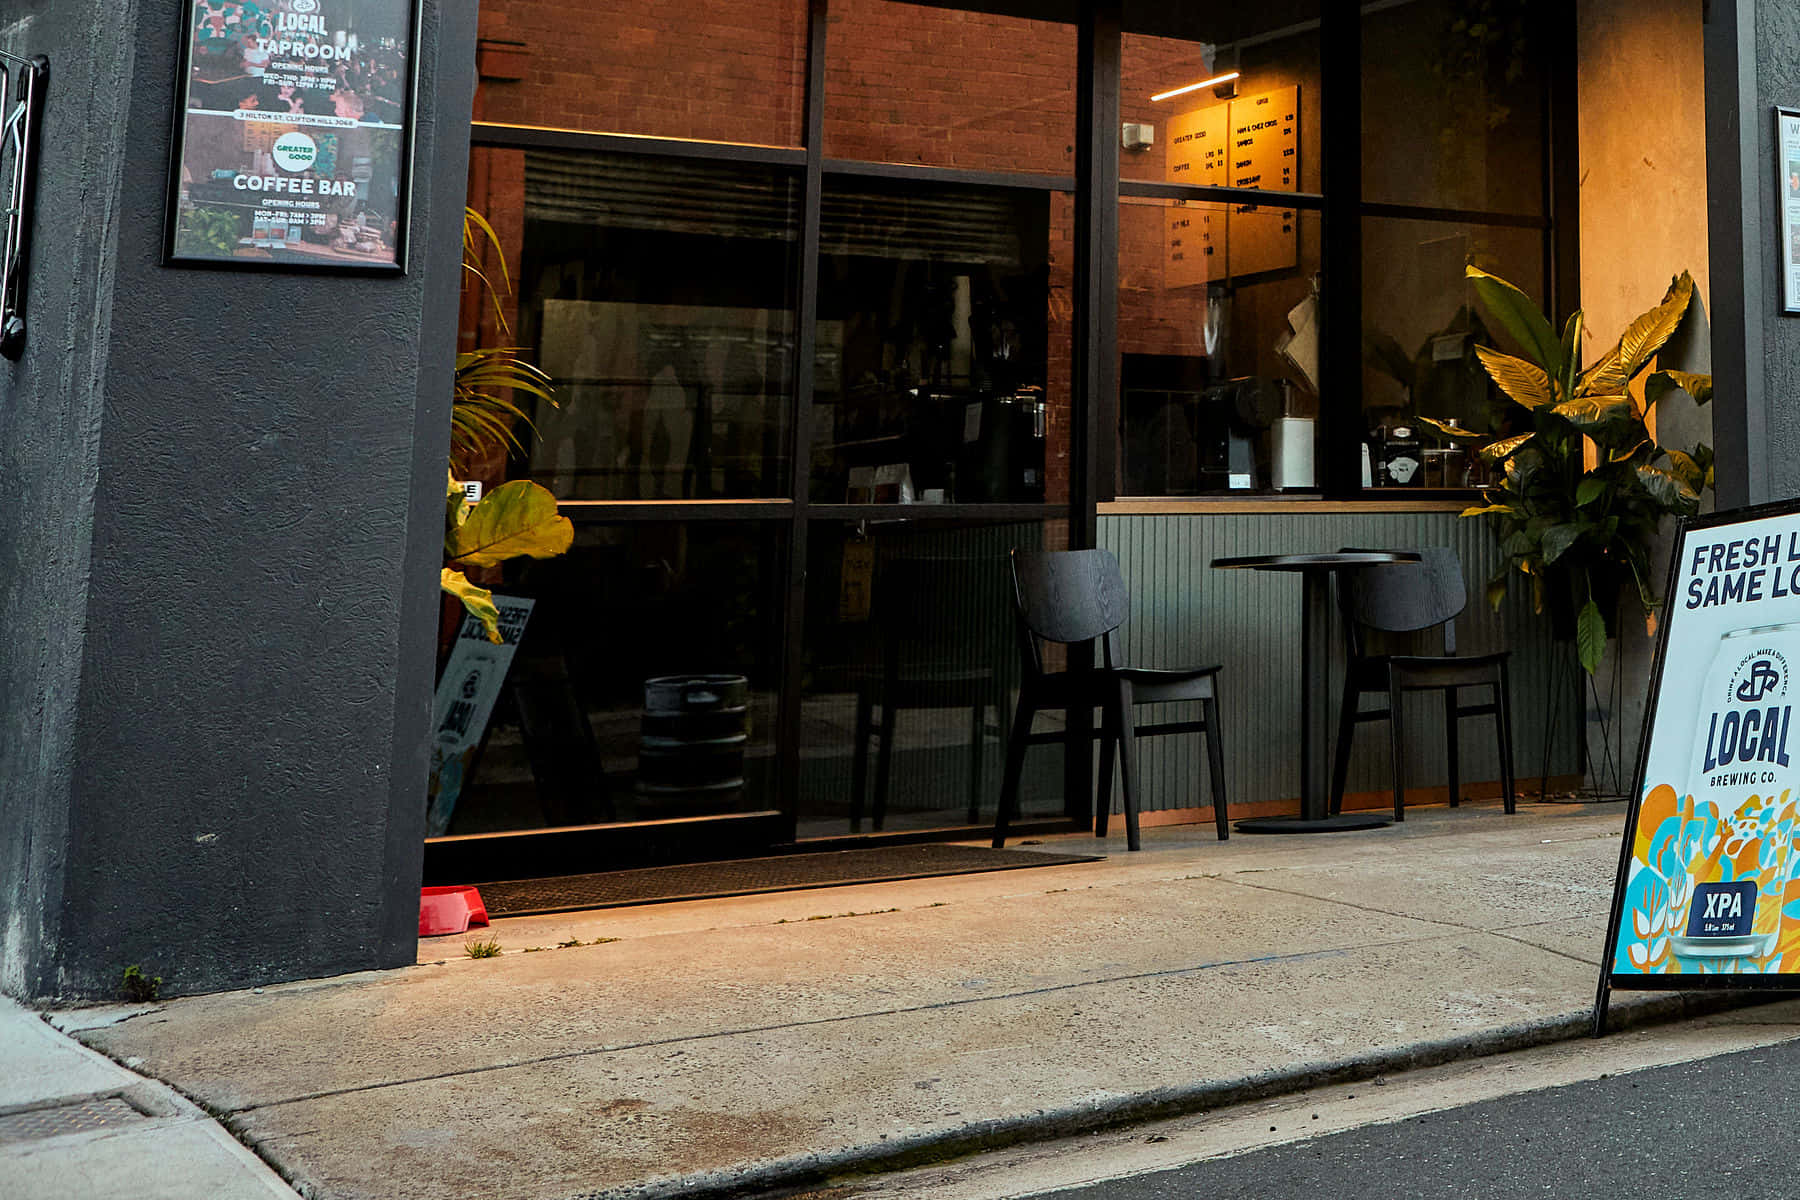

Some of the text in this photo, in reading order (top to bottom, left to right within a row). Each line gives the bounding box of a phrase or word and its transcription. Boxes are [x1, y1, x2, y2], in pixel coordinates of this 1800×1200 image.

[278, 12, 328, 36] LOCAL
[255, 38, 351, 61] TAPROOM
[272, 62, 329, 73] OPENING HOURS
[276, 144, 313, 154] GREATER
[288, 152, 313, 161] GOOD
[233, 174, 356, 198] COFFEE BAR
[262, 199, 320, 209] OPENING HOURS
[1691, 534, 1782, 576] FRESH
[1686, 569, 1766, 609] SAME
[1737, 653, 1756, 671] LOCAL
[1703, 705, 1791, 774] LOCAL
[1710, 772, 1777, 787] BREWING CO.
[1702, 892, 1741, 919] XPA
